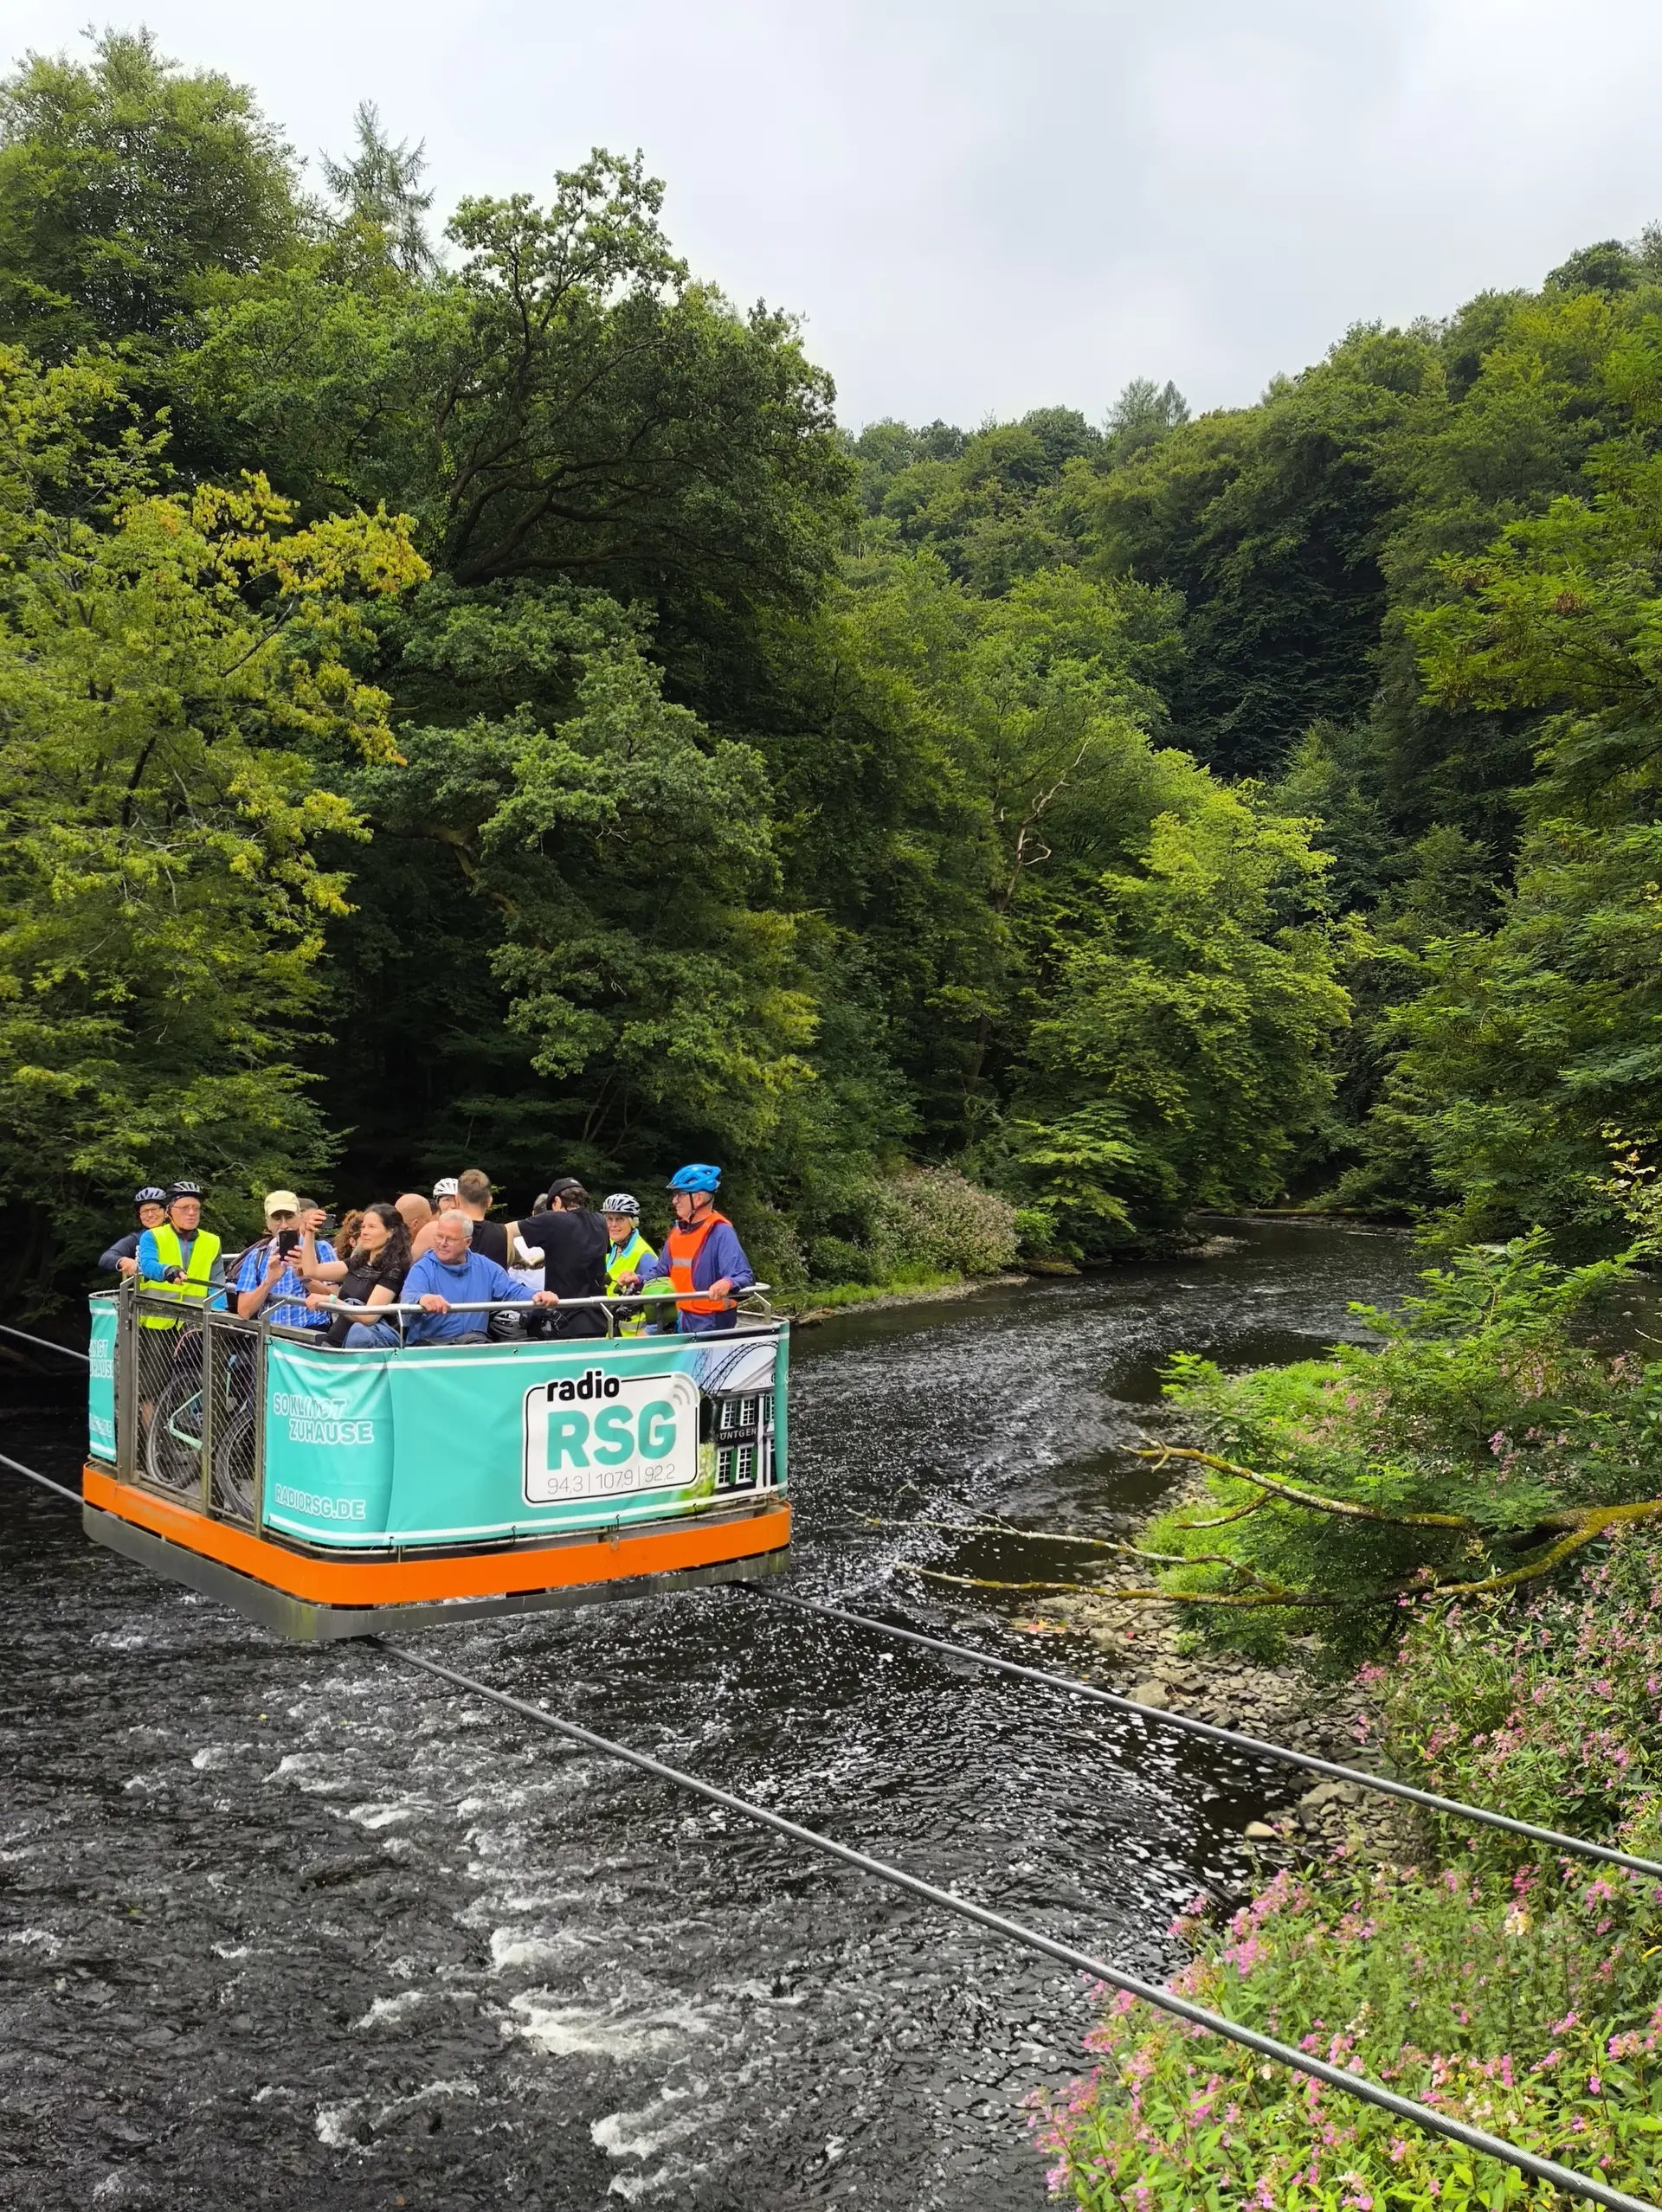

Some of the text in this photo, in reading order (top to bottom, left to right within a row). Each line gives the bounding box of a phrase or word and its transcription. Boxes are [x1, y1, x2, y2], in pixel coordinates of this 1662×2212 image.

[547, 1371, 620, 1402] radio
[274, 1392, 289, 1416] SO
[289, 1418, 374, 1444] ZUHAUSE
[547, 1400, 676, 1470] RSG
[547, 1476, 583, 1495] 94,3
[644, 1463, 676, 1483] 92,2
[275, 1483, 366, 1520] RADIORSG.DE
